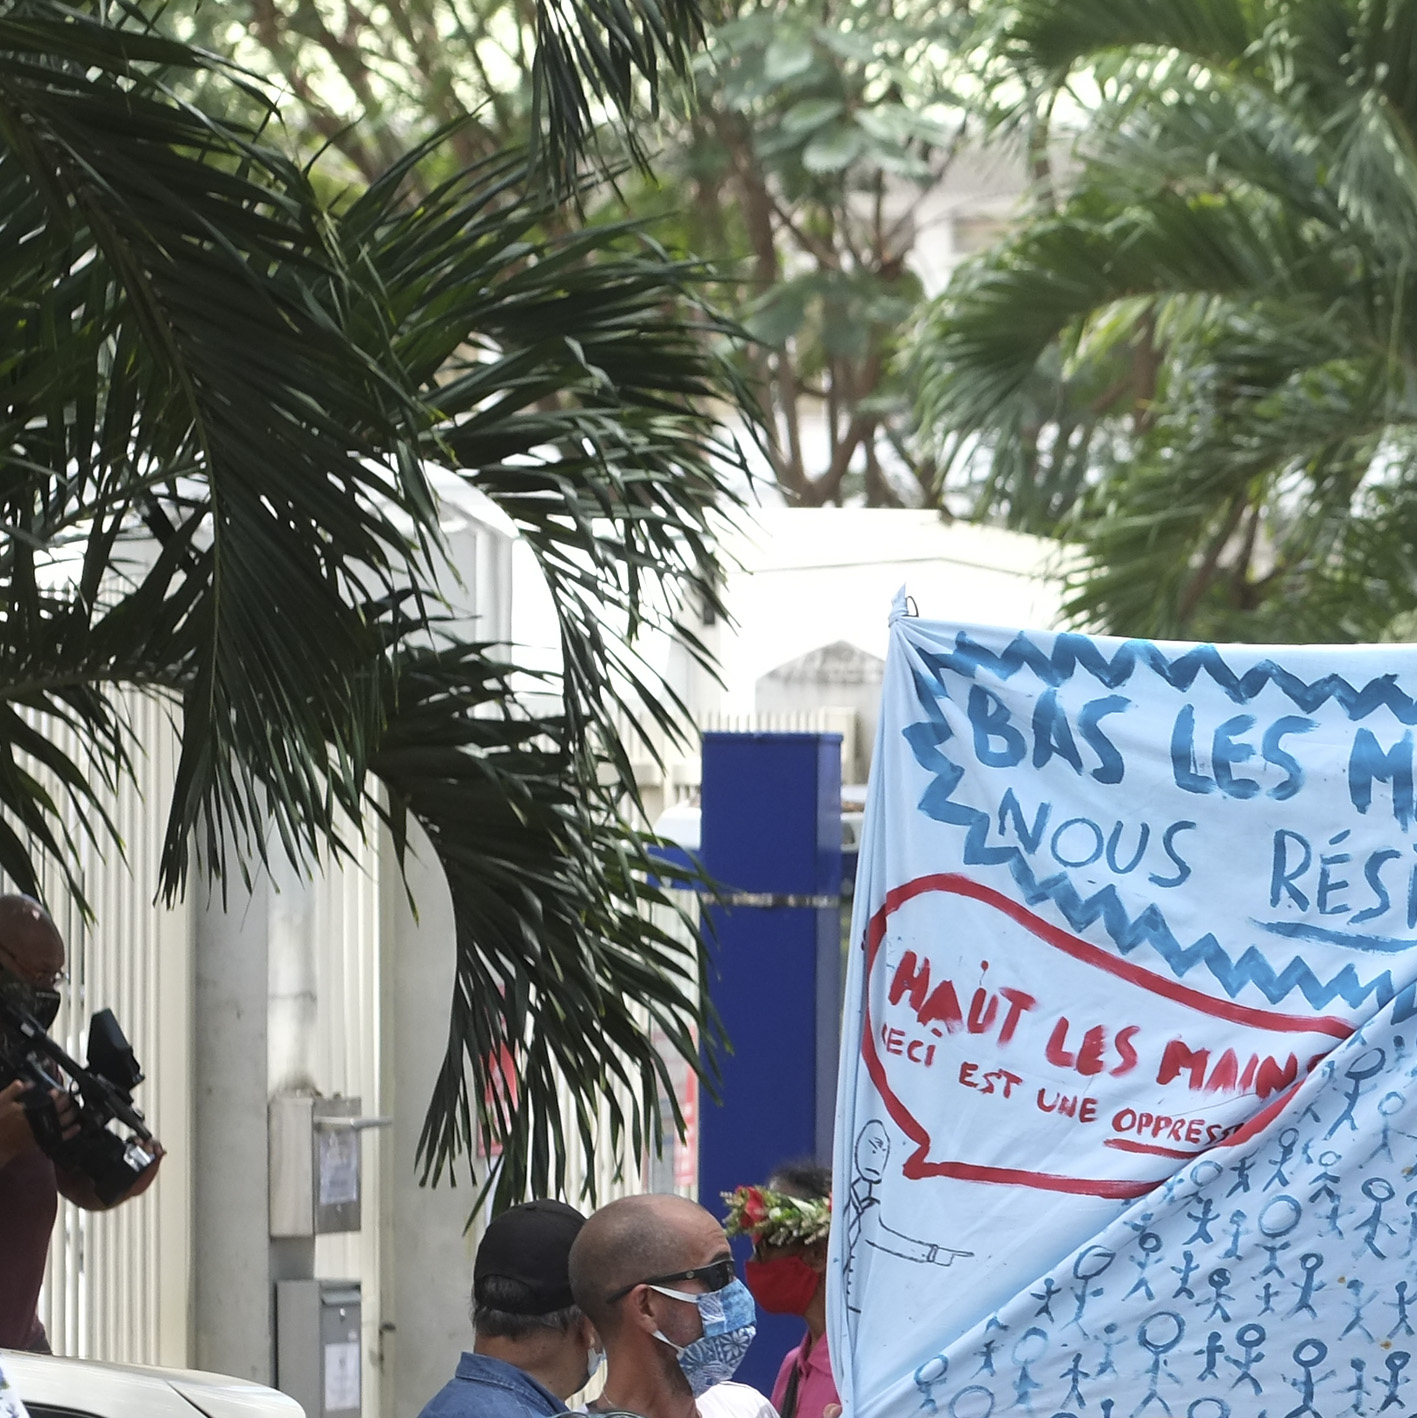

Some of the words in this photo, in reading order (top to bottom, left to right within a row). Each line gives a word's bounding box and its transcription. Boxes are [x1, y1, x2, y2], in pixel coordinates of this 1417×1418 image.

[968, 685, 1132, 784] BAS
[1170, 703, 1319, 801] LES
[998, 787, 1197, 888] NOUS
[888, 949, 1039, 1045] HAUT
[1045, 1017, 1141, 1077] LES
[1156, 1034, 1326, 1099] MAIN
[959, 1061, 1022, 1100] EST
[1036, 1087, 1098, 1123] UNE
